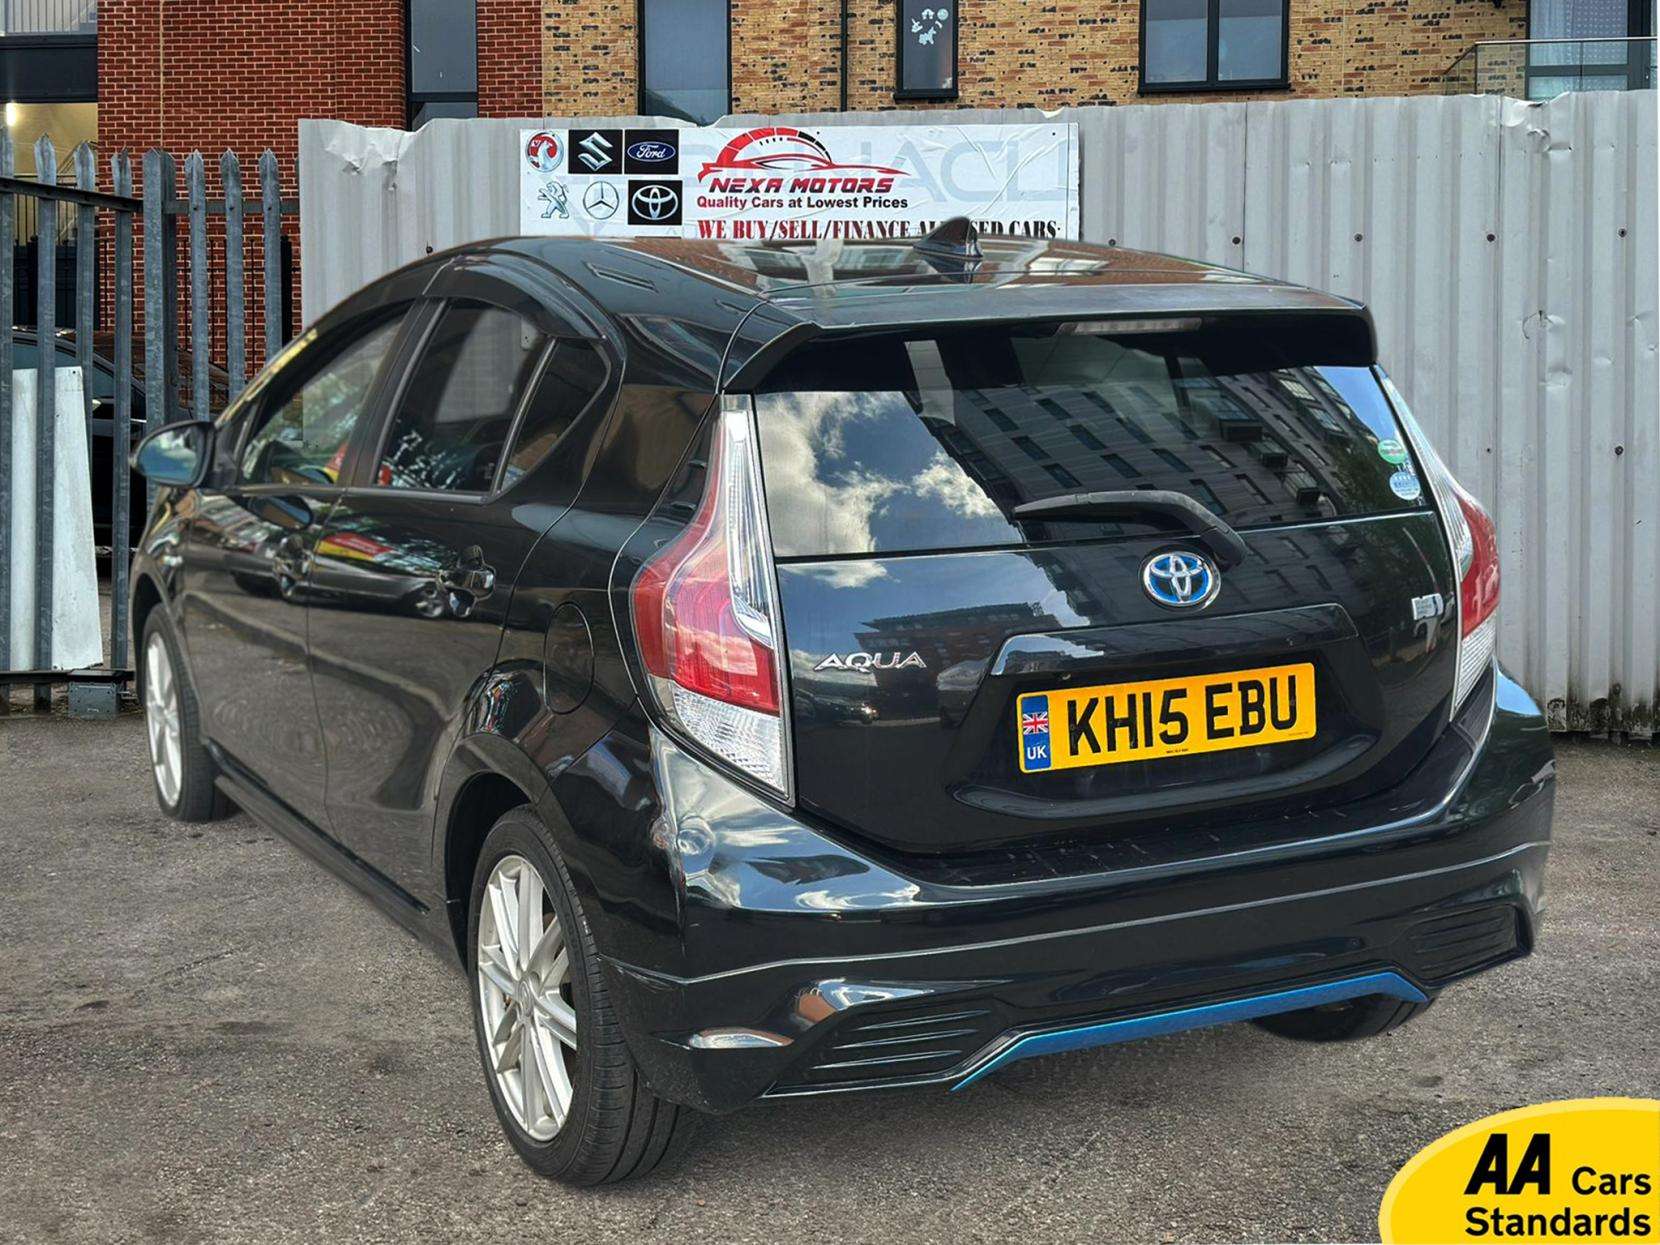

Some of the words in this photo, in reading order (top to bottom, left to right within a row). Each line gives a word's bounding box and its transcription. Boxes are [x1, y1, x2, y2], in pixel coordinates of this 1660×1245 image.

[635, 144, 666, 158] Ford
[708, 177, 783, 194] NEXA
[789, 177, 895, 194] MOTORS
[696, 195, 748, 211] Quality
[752, 196, 784, 209] Cars
[788, 196, 803, 209] at
[806, 196, 859, 209] Lowest
[863, 196, 909, 209] Prices
[697, 219, 727, 240] WE
[968, 220, 1005, 237] SED
[814, 651, 928, 673] AQUA
[1067, 687, 1190, 757] KH15
[1204, 675, 1298, 741] EBU
[1026, 745, 1048, 760] UK
